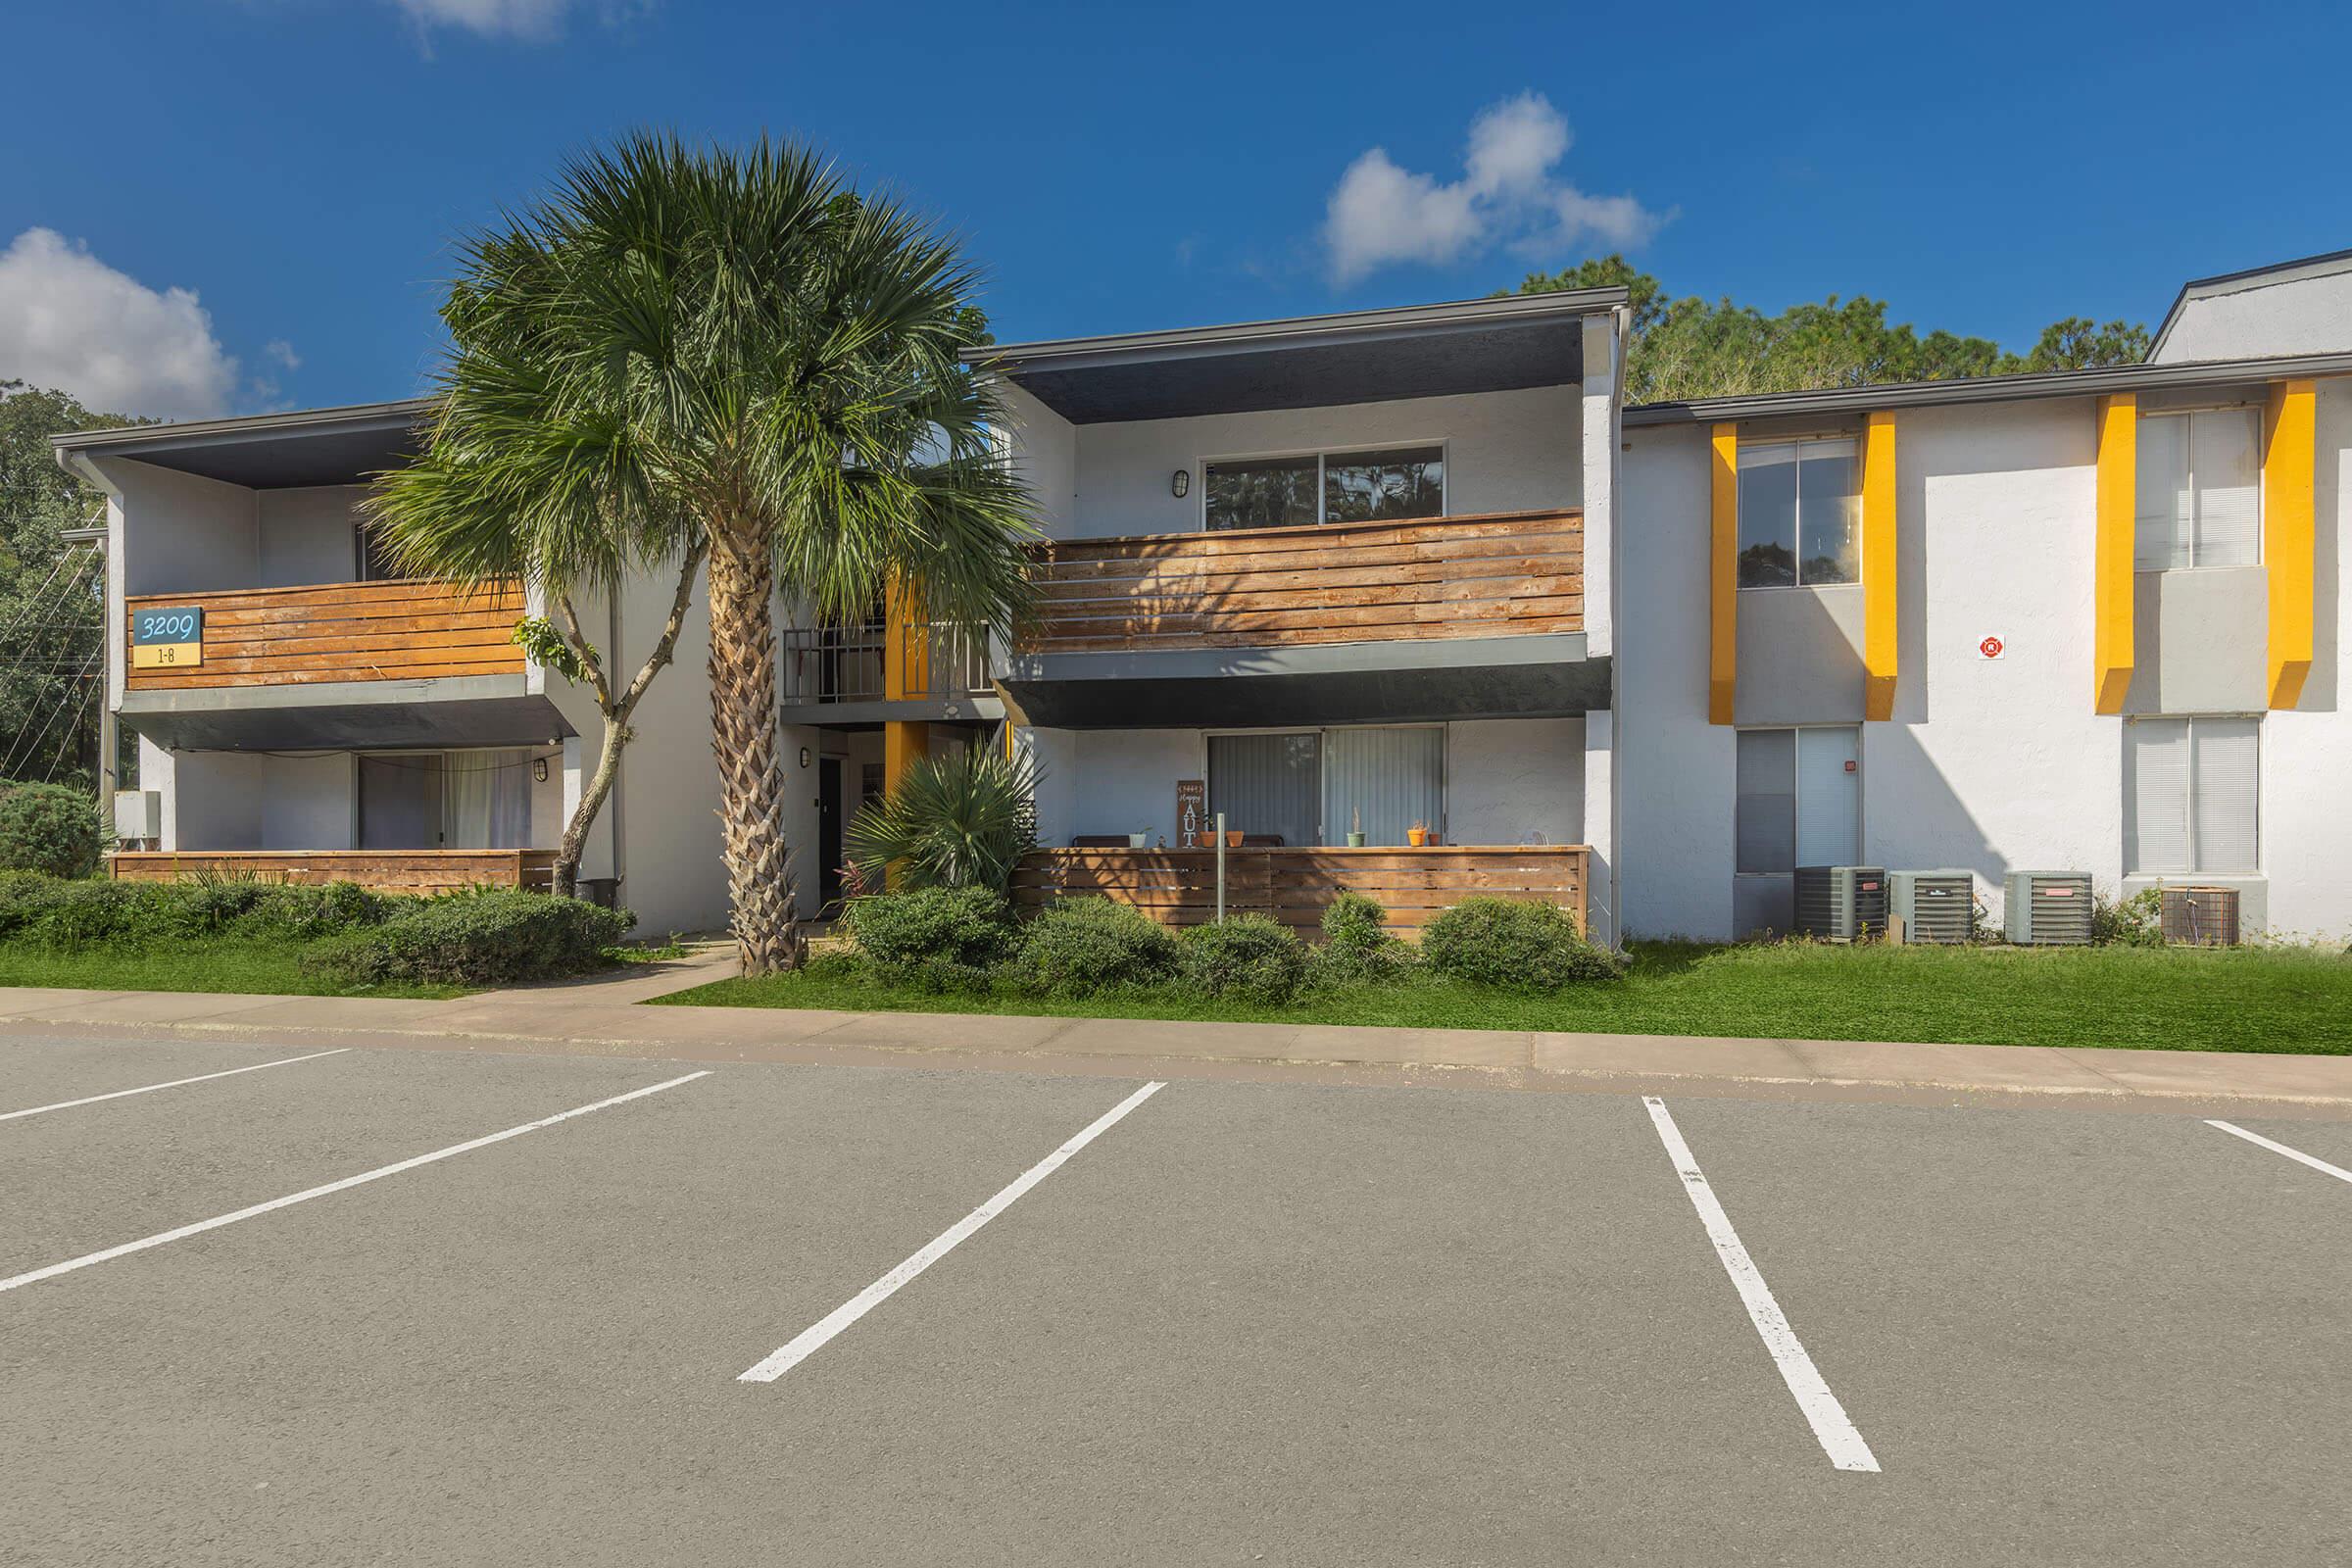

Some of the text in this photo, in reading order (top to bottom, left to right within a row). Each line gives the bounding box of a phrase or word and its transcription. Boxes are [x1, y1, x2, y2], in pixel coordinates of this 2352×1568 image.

[141, 614, 194, 640] 3209
[158, 648, 174, 663] 1-8
[1183, 804, 1197, 850] AUT
